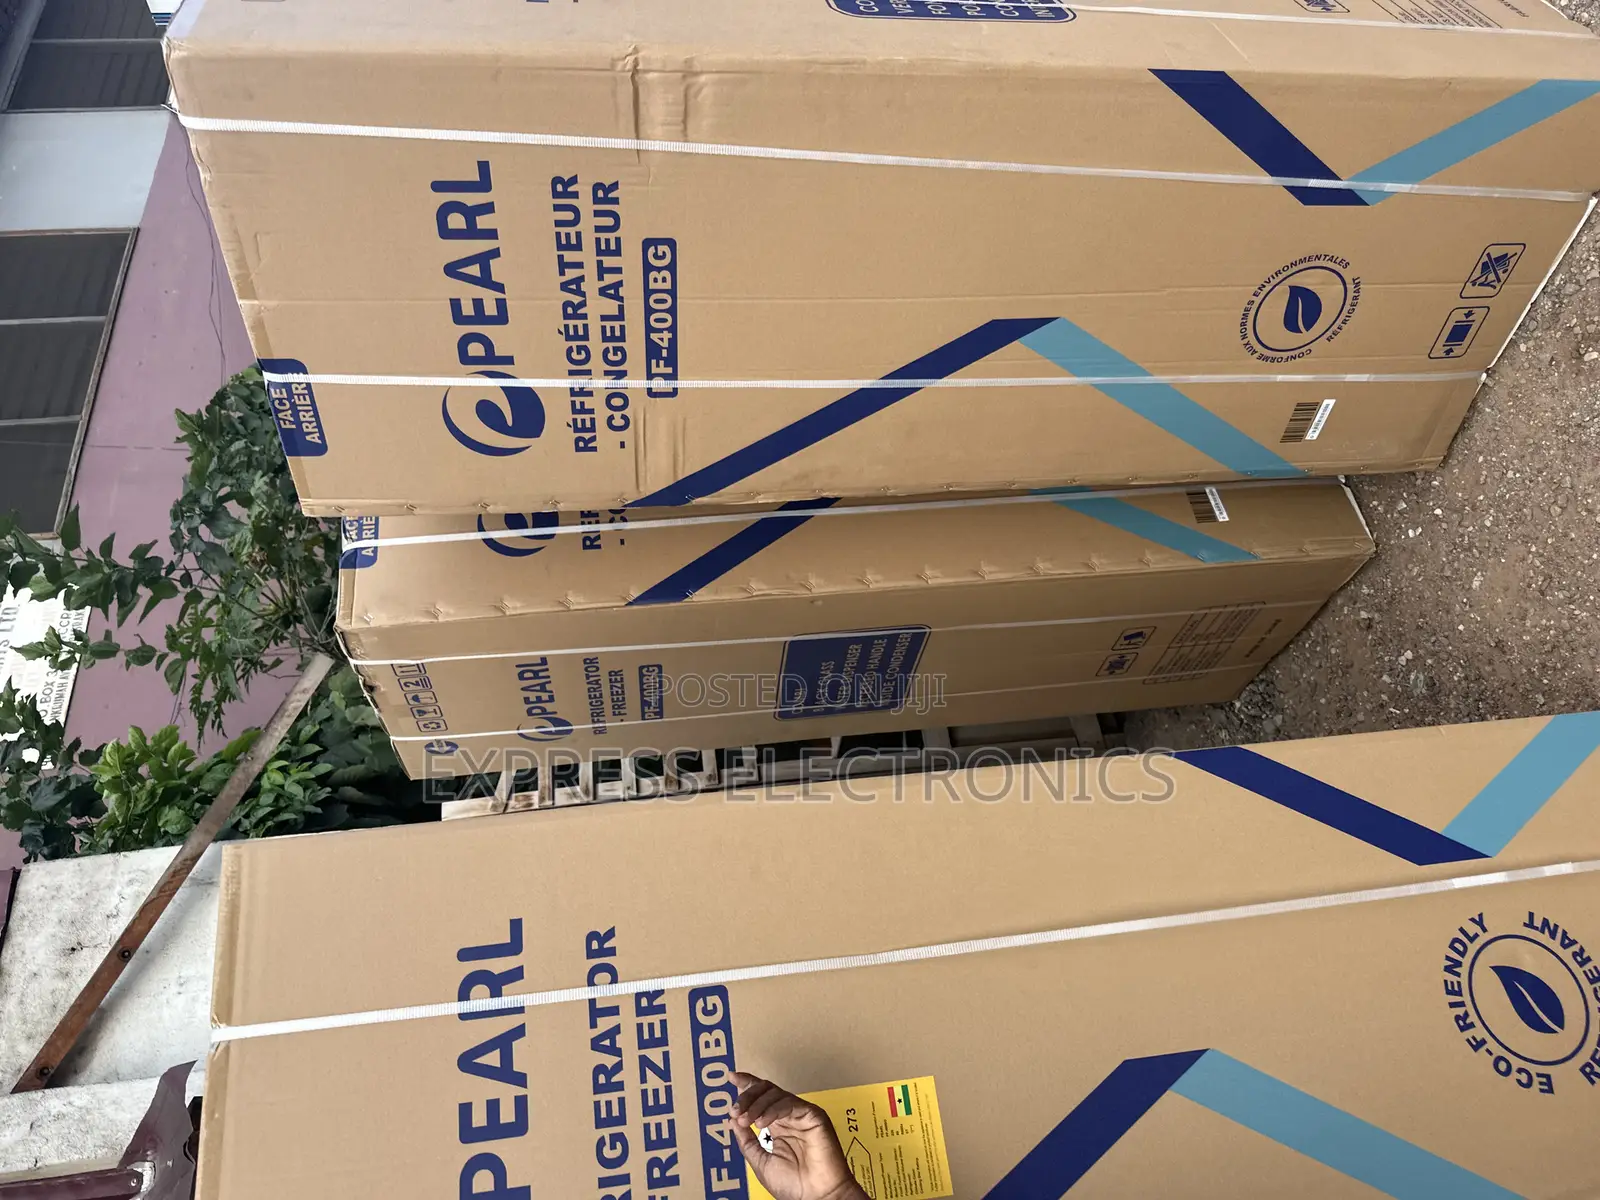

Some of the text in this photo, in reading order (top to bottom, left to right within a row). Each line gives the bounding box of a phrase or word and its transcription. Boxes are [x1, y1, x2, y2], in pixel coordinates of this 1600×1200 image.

[430, 160, 515, 366] PEARL
[550, 174, 598, 453] RÉFRIGÉRATEUR
[591, 180, 630, 432] CONGELATEUR
[642, 244, 674, 393] PF-400BG
[1240, 254, 1350, 364] CONFORME AUX NORMES ENVIRONMENTALES
[270, 388, 297, 429] FACE
[291, 372, 322, 444] ARRIÈR
[514, 656, 558, 716] PEARL
[608, 669, 627, 716] FREEZER
[866, 638, 888, 670] HANDLE
[885, 632, 912, 680] CONDENSER
[456, 917, 531, 1200] PEARL
[1442, 912, 1555, 1094] ECO-FRIENDLY
[634, 987, 680, 1200] REEZER
[695, 994, 741, 1200] F-400BG
[846, 1108, 859, 1132] 273
